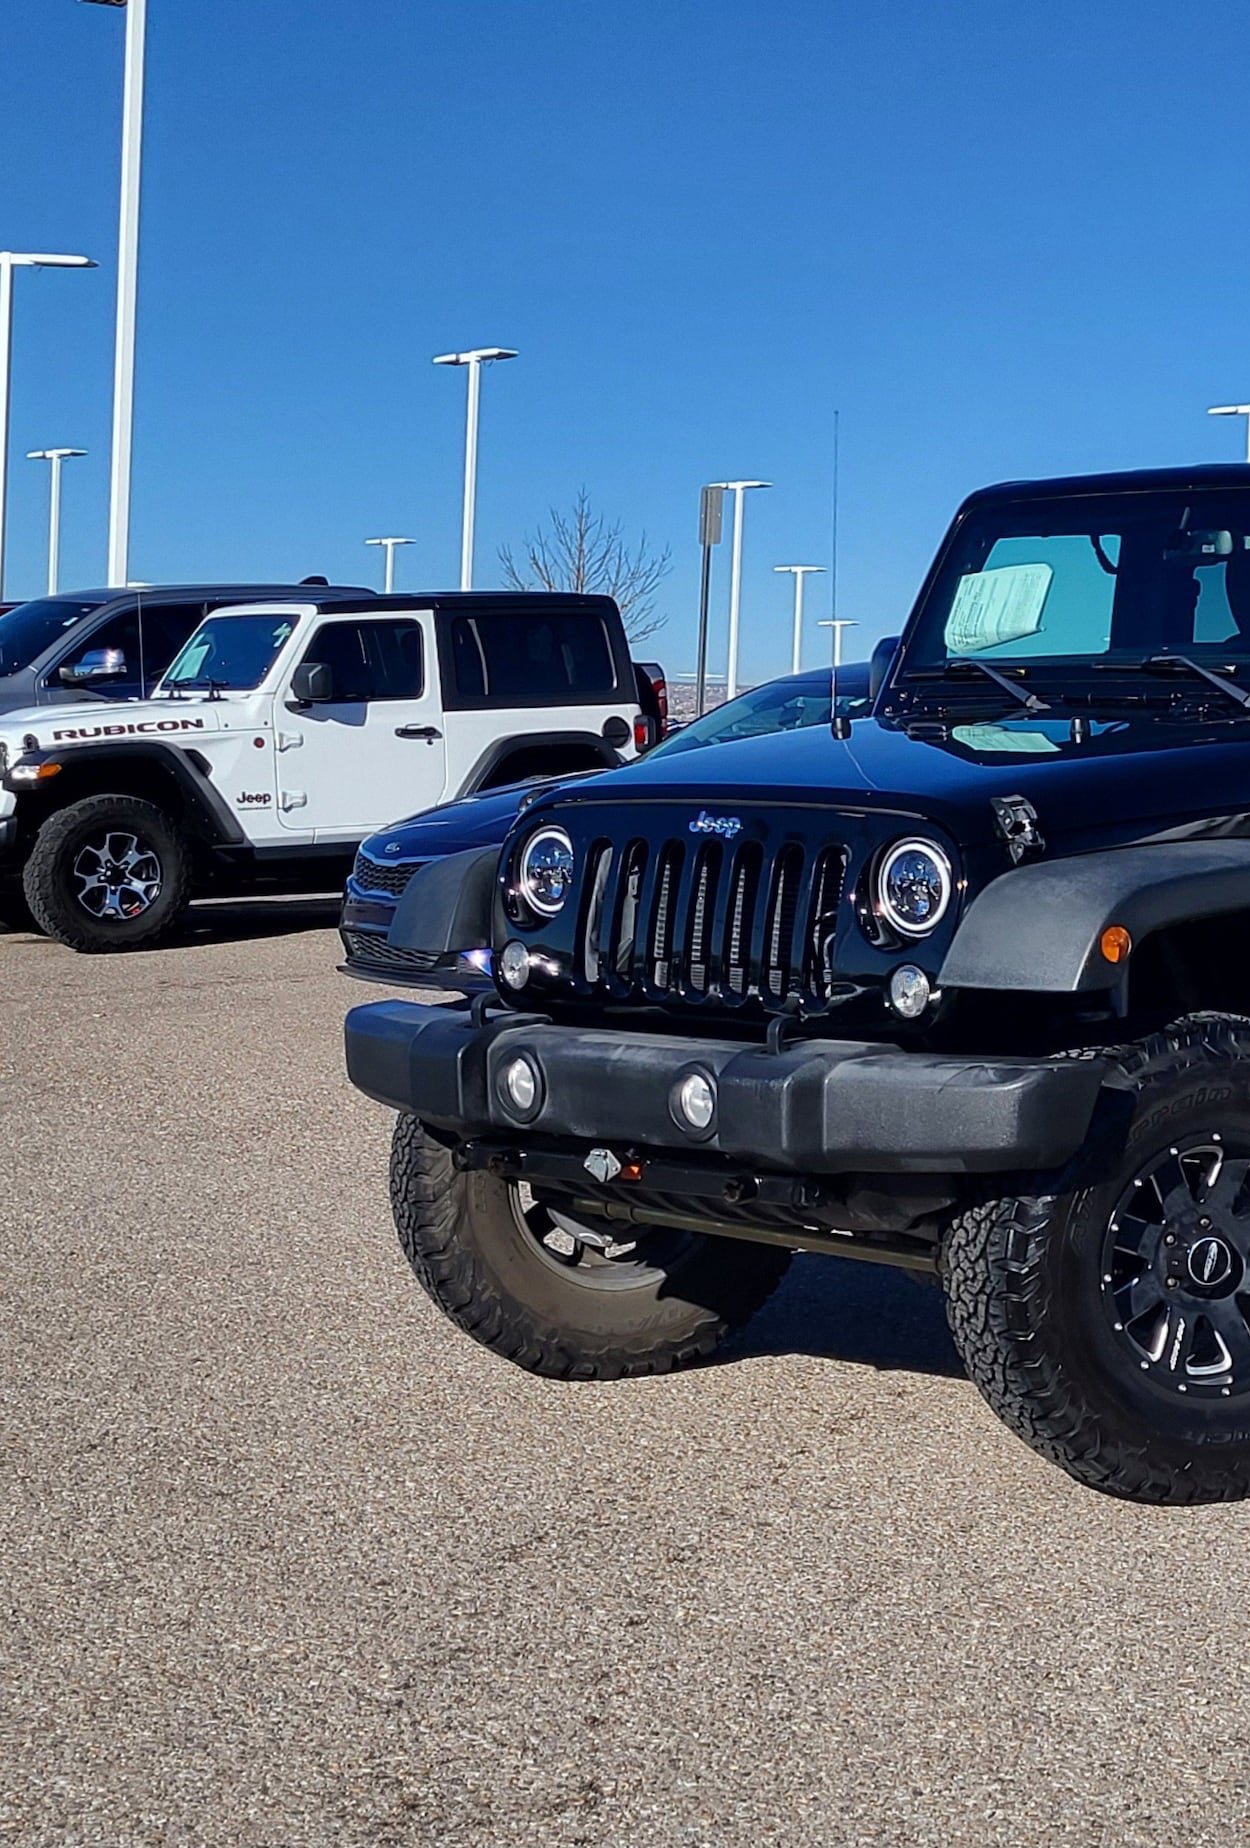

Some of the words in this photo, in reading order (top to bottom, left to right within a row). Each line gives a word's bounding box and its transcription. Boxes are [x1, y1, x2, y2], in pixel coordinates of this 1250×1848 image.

[52, 718, 204, 741] RUBICON
[236, 791, 272, 804] Jeep
[689, 810, 742, 838] Jeep
